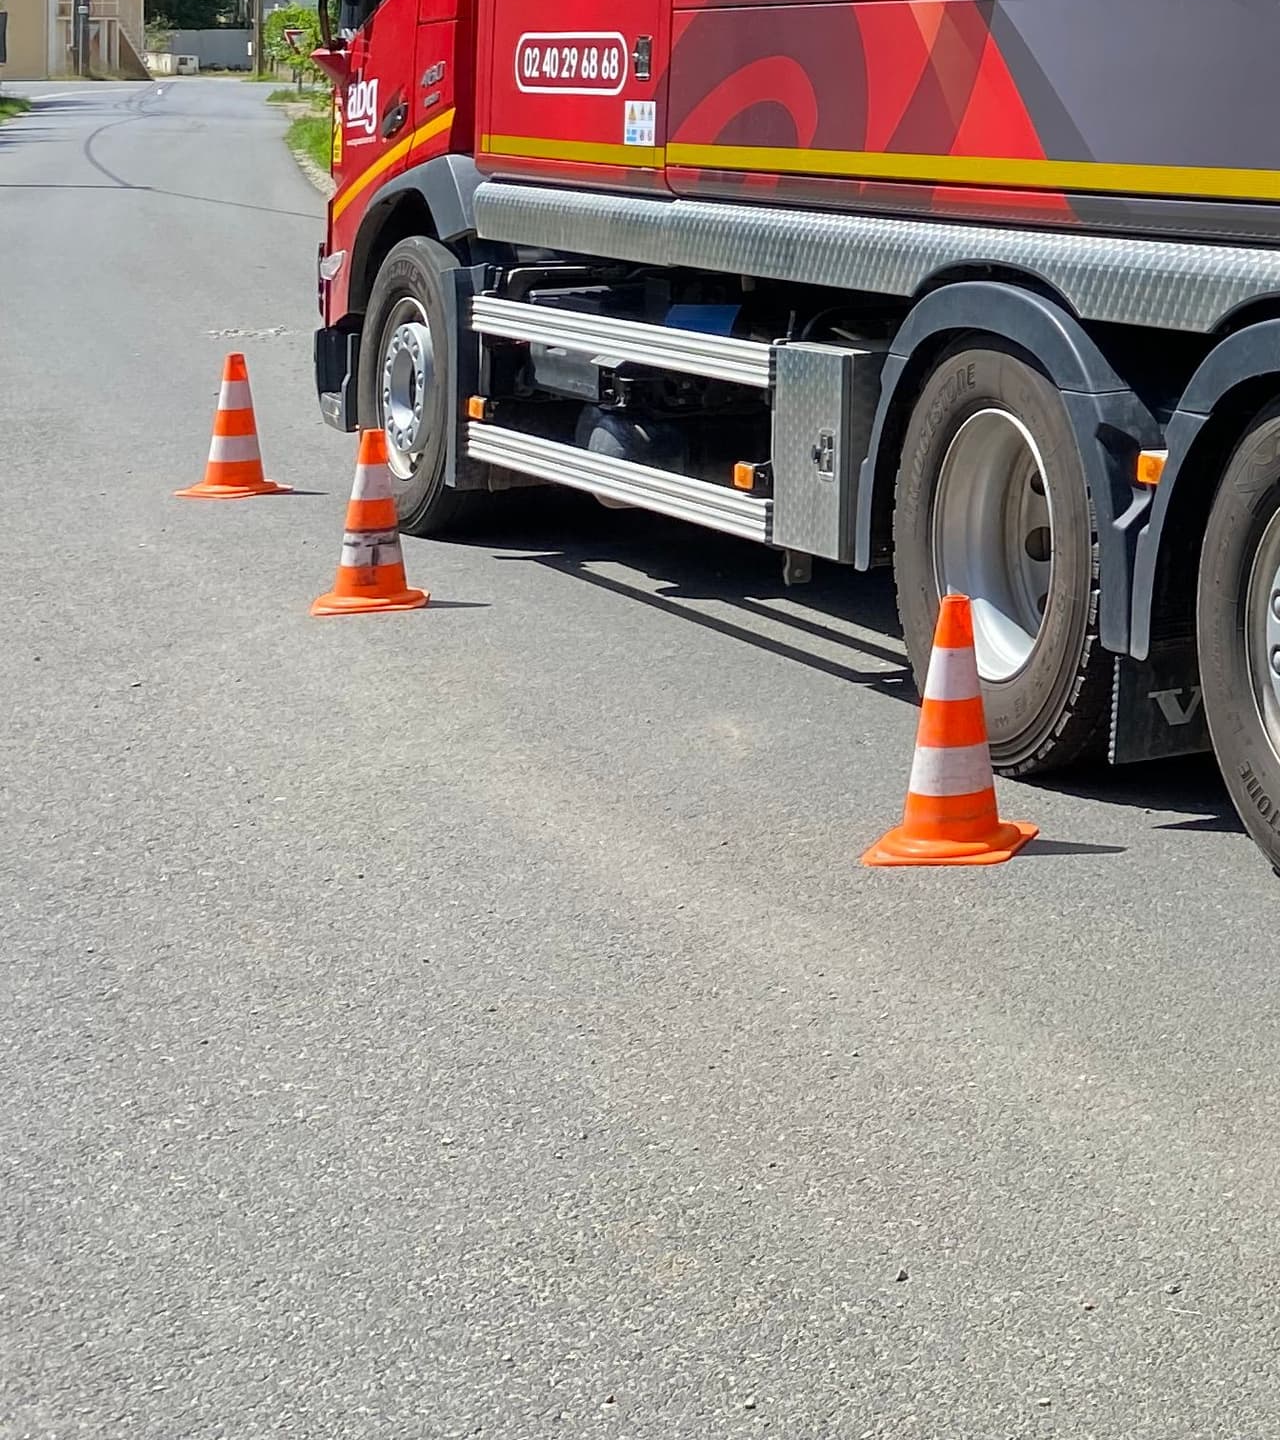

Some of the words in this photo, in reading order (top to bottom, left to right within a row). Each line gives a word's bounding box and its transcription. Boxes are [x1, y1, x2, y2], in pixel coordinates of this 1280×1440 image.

[523, 47, 539, 78] 02
[542, 47, 559, 78] 40
[561, 47, 578, 78] 29
[581, 47, 598, 78] 68
[601, 47, 619, 78] 68
[347, 68, 378, 135] abg
